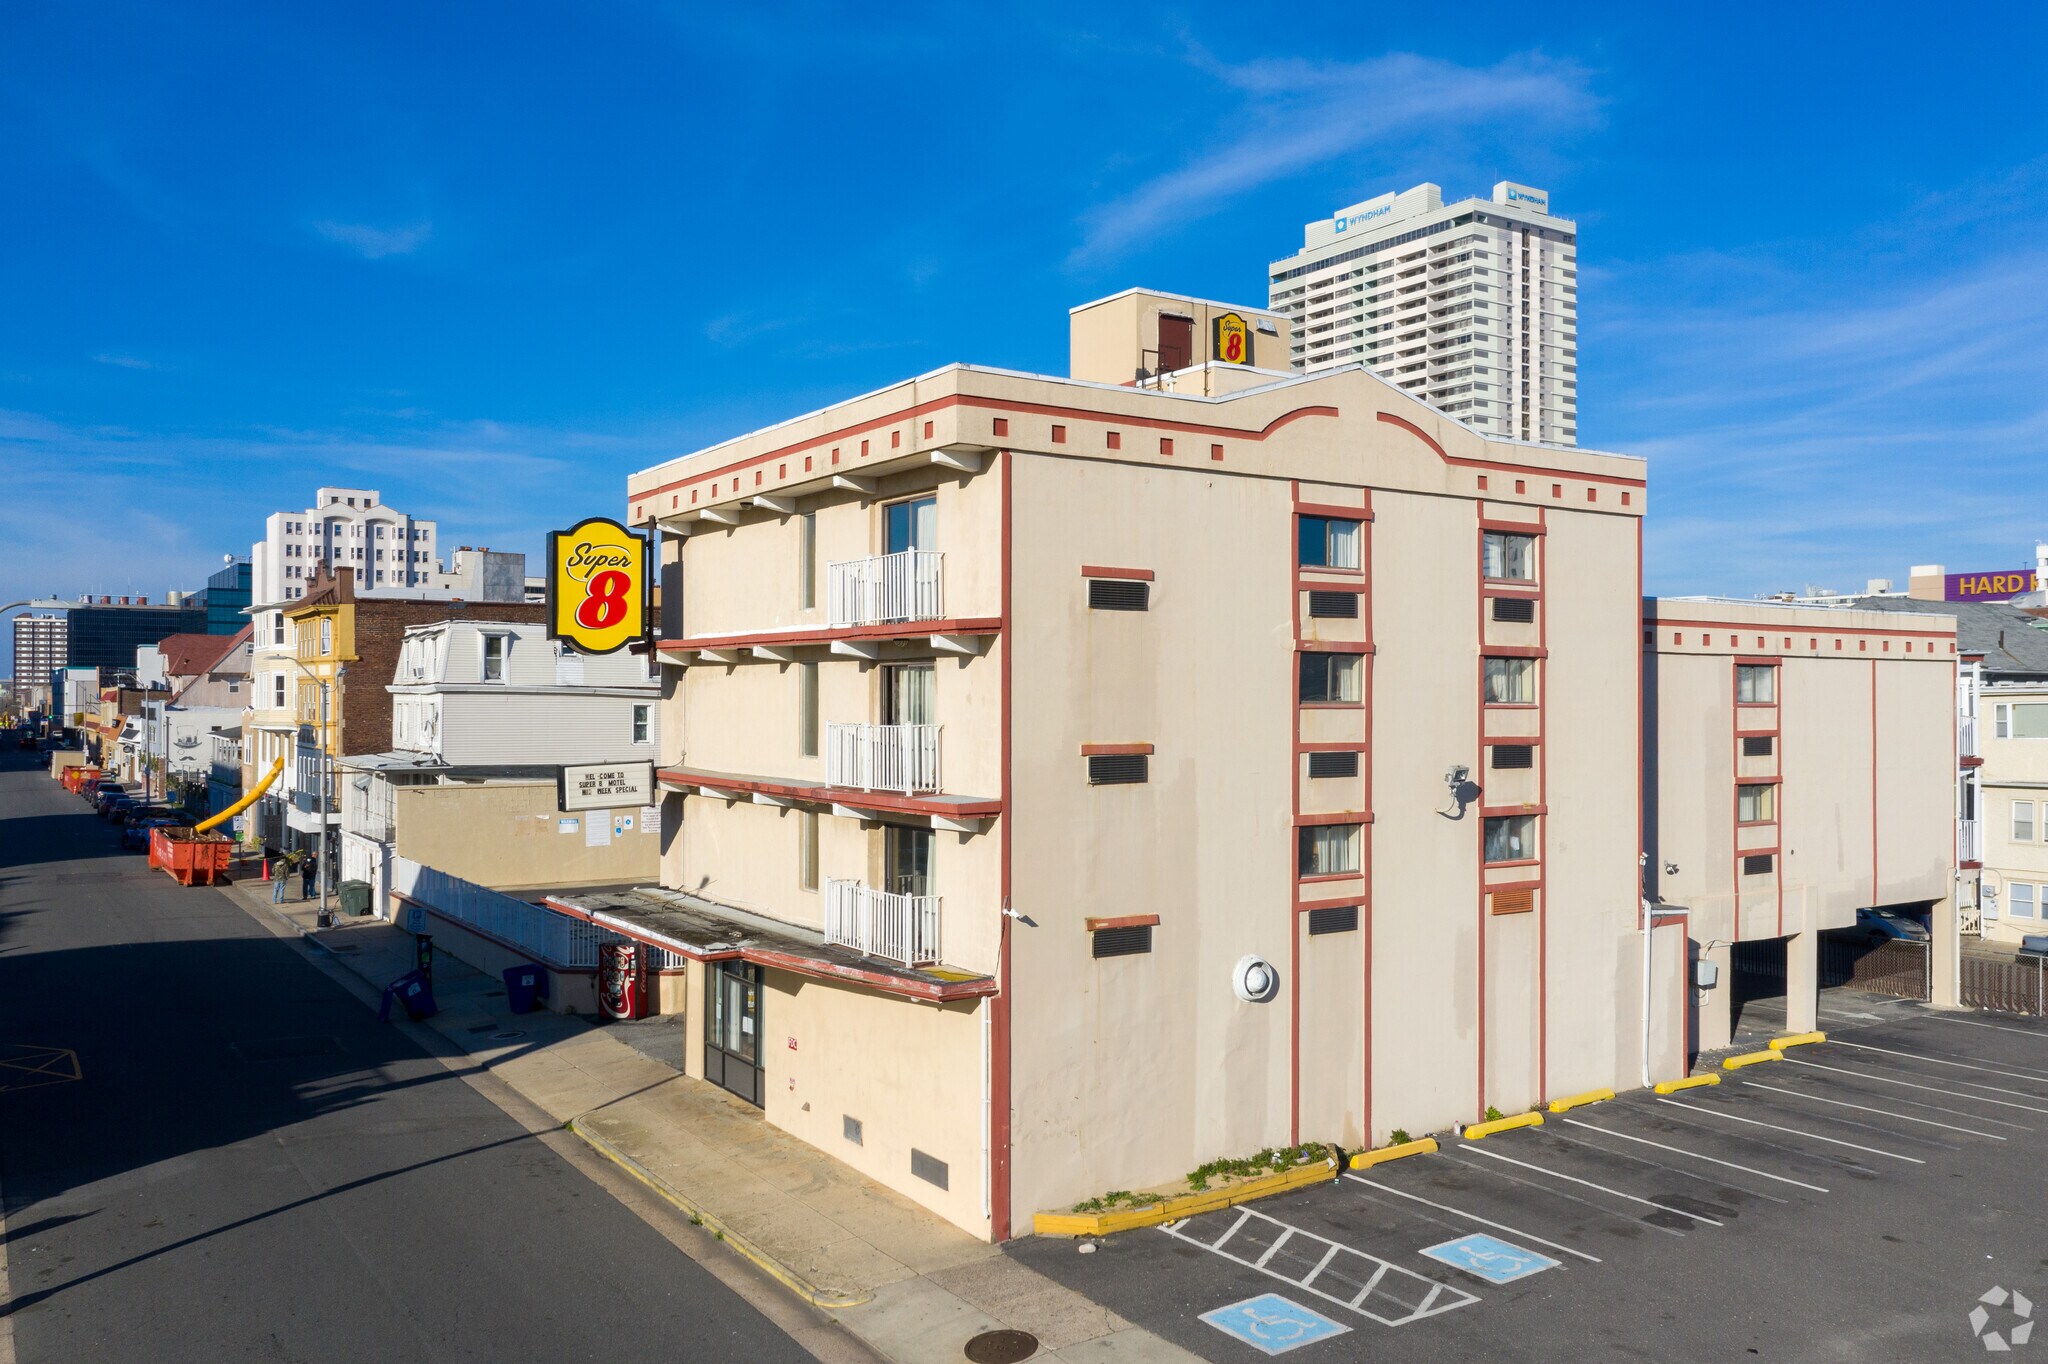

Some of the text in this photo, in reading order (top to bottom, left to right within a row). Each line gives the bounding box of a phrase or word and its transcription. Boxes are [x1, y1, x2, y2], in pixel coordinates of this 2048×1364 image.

[1350, 205, 1391, 226] WYNDHAM
[1223, 320, 1241, 337] Super
[1226, 333, 1242, 361] 8
[567, 542, 632, 579] Super
[1960, 575, 2024, 595] HARD
[575, 570, 631, 630] 8
